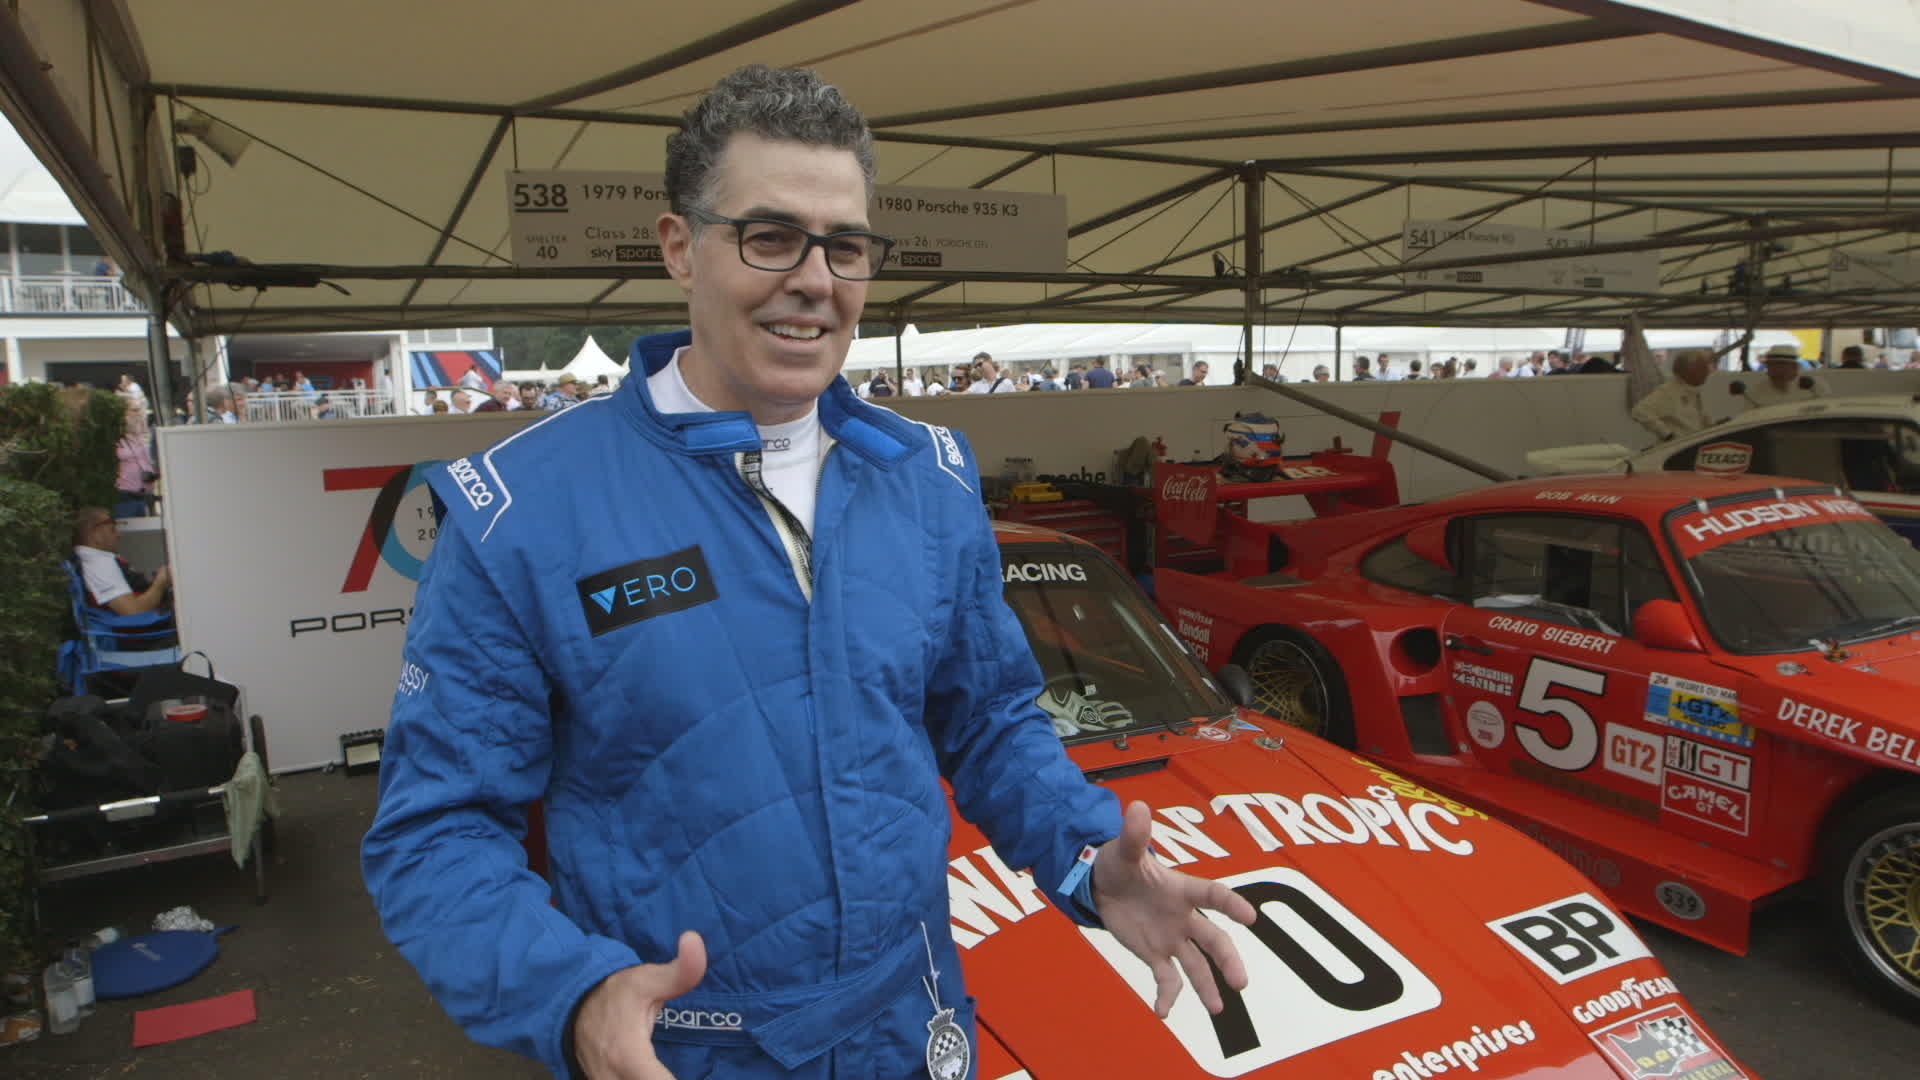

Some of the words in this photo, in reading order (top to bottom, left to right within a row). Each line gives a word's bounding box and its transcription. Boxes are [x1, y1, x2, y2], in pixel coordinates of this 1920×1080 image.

[513, 184, 568, 207] 538
[583, 185, 626, 199] 1979
[633, 187, 667, 200] Pors
[878, 198, 912, 212] 1980
[917, 200, 969, 215] Porsche
[974, 203, 998, 216] 935
[1002, 206, 1019, 217] K3
[584, 227, 626, 240] Class
[632, 228, 654, 240] 28:
[1409, 230, 1437, 246] 541
[536, 246, 558, 259] 40
[591, 249, 612, 261] sky
[902, 253, 941, 265] sports
[1700, 452, 1746, 466] TEXACO
[448, 457, 494, 511] sparco
[1577, 493, 1622, 504] AKIN
[1683, 499, 1818, 541] HUDSON
[589, 566, 696, 614] VERO
[290, 608, 413, 637] POR
[1488, 615, 1539, 636] CRAIG
[1541, 626, 1617, 653] SIEBERT
[1653, 675, 1669, 685] 24
[1514, 656, 1608, 773] 5
[1776, 697, 1863, 744] DEREK
[1611, 734, 1657, 774] GT2
[1701, 750, 1748, 781] GT
[1668, 785, 1744, 821] CAMEL
[1696, 801, 1715, 814] GT
[1210, 787, 1474, 856] TROPIC
[1661, 884, 1698, 913] 539
[1500, 902, 1620, 975] BP
[1372, 1019, 1536, 1080] enterprises
